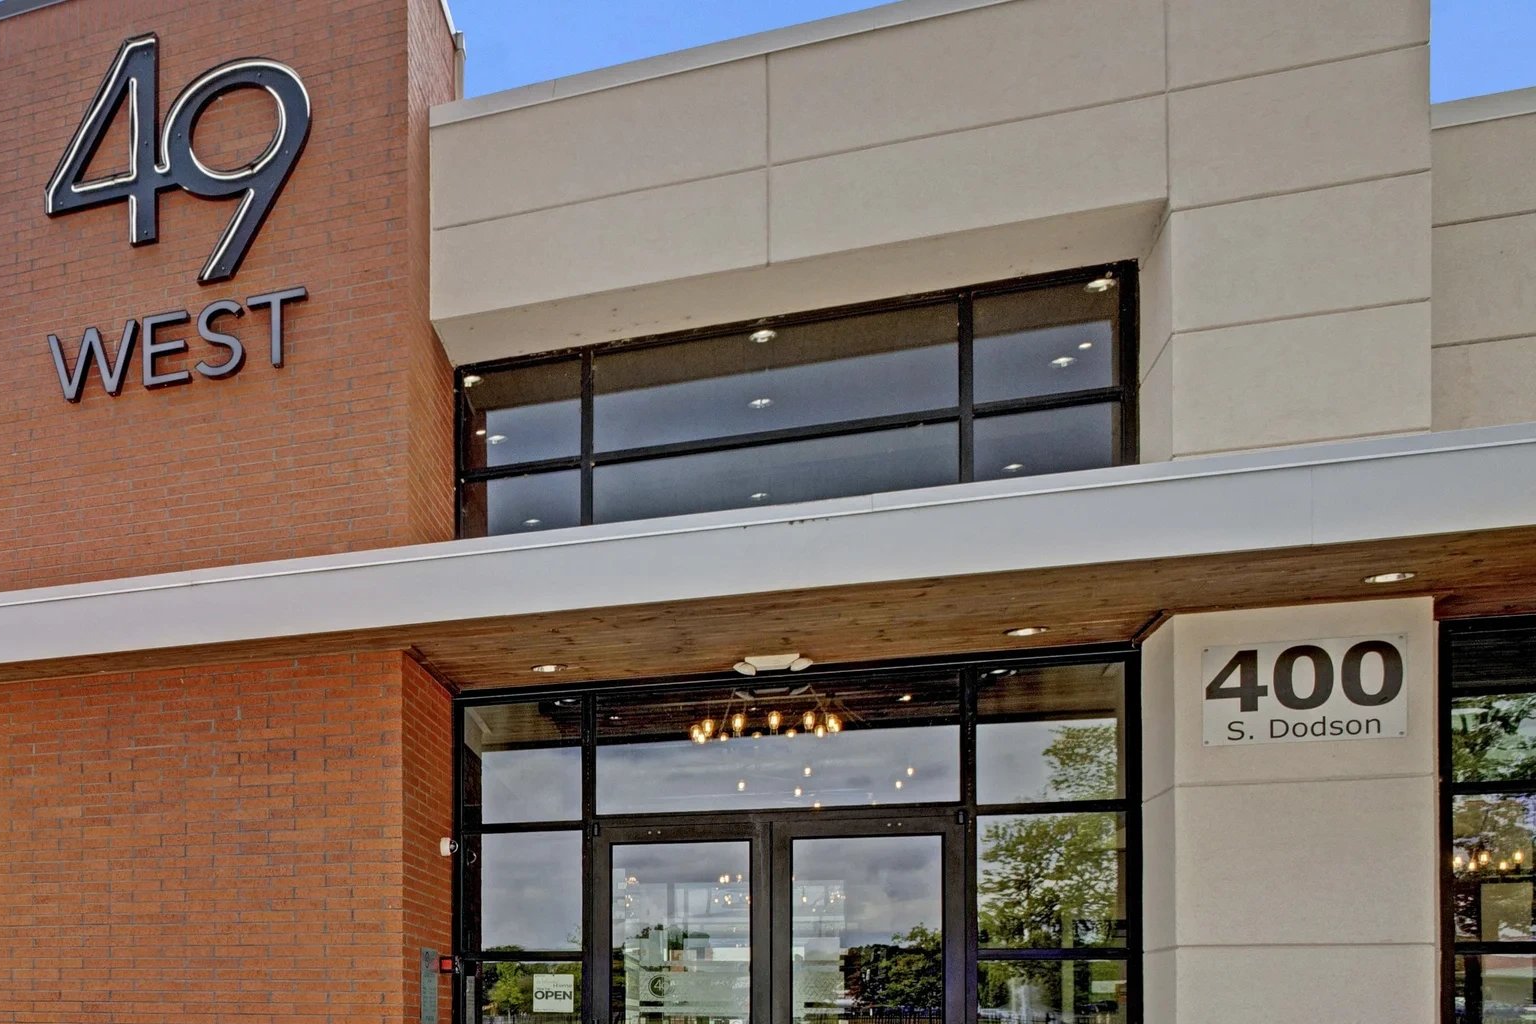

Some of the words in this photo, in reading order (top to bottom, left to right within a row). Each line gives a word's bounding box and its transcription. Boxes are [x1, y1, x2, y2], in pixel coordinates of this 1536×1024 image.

[44, 31, 312, 285] 49
[46, 286, 309, 402] WEST
[1205, 640, 1403, 712] 400
[1227, 721, 1254, 741] S.
[1270, 716, 1381, 739] Dodson
[534, 990, 573, 1000] OPEN
